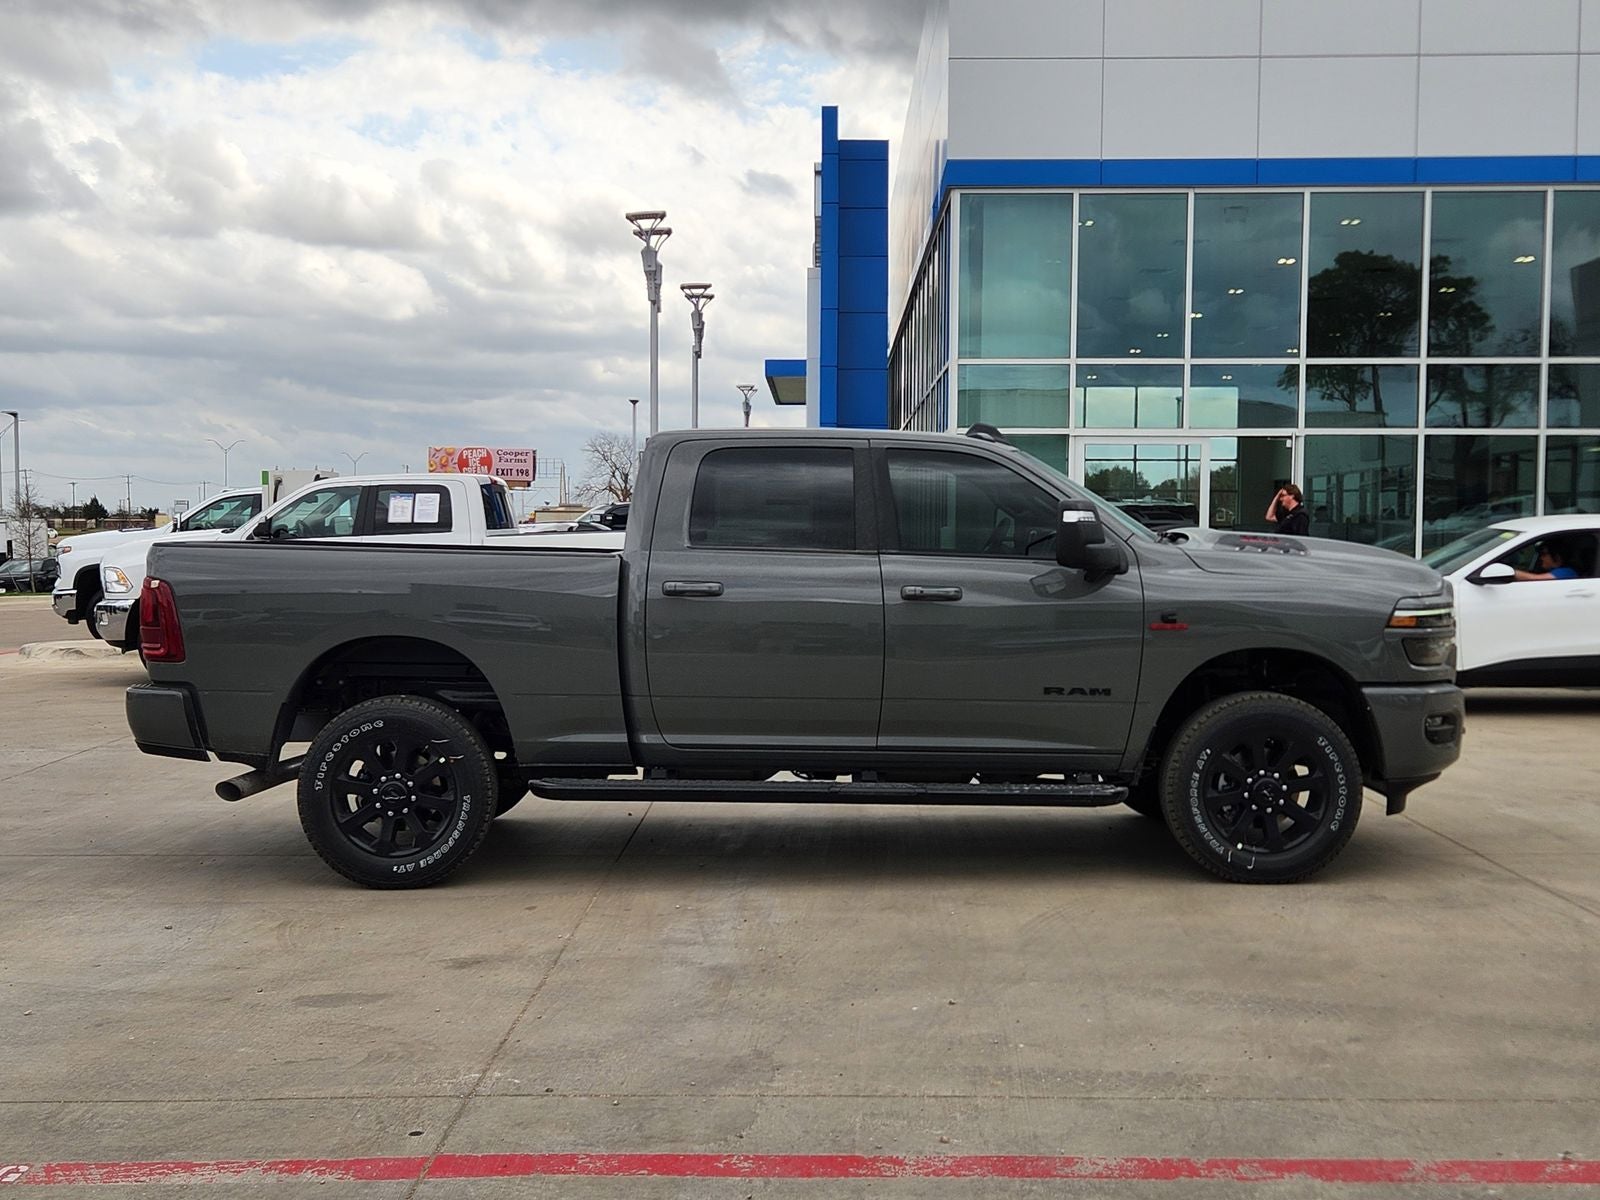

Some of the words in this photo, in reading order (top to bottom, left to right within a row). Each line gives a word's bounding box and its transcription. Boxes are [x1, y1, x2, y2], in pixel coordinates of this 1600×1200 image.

[463, 449, 487, 459] PEACH
[496, 449, 531, 458] Cooper
[468, 458, 481, 466] ICE
[498, 456, 528, 464] Farms
[496, 468, 514, 477] EXIT
[516, 468, 530, 477] 198
[1043, 686, 1112, 697] RAM
